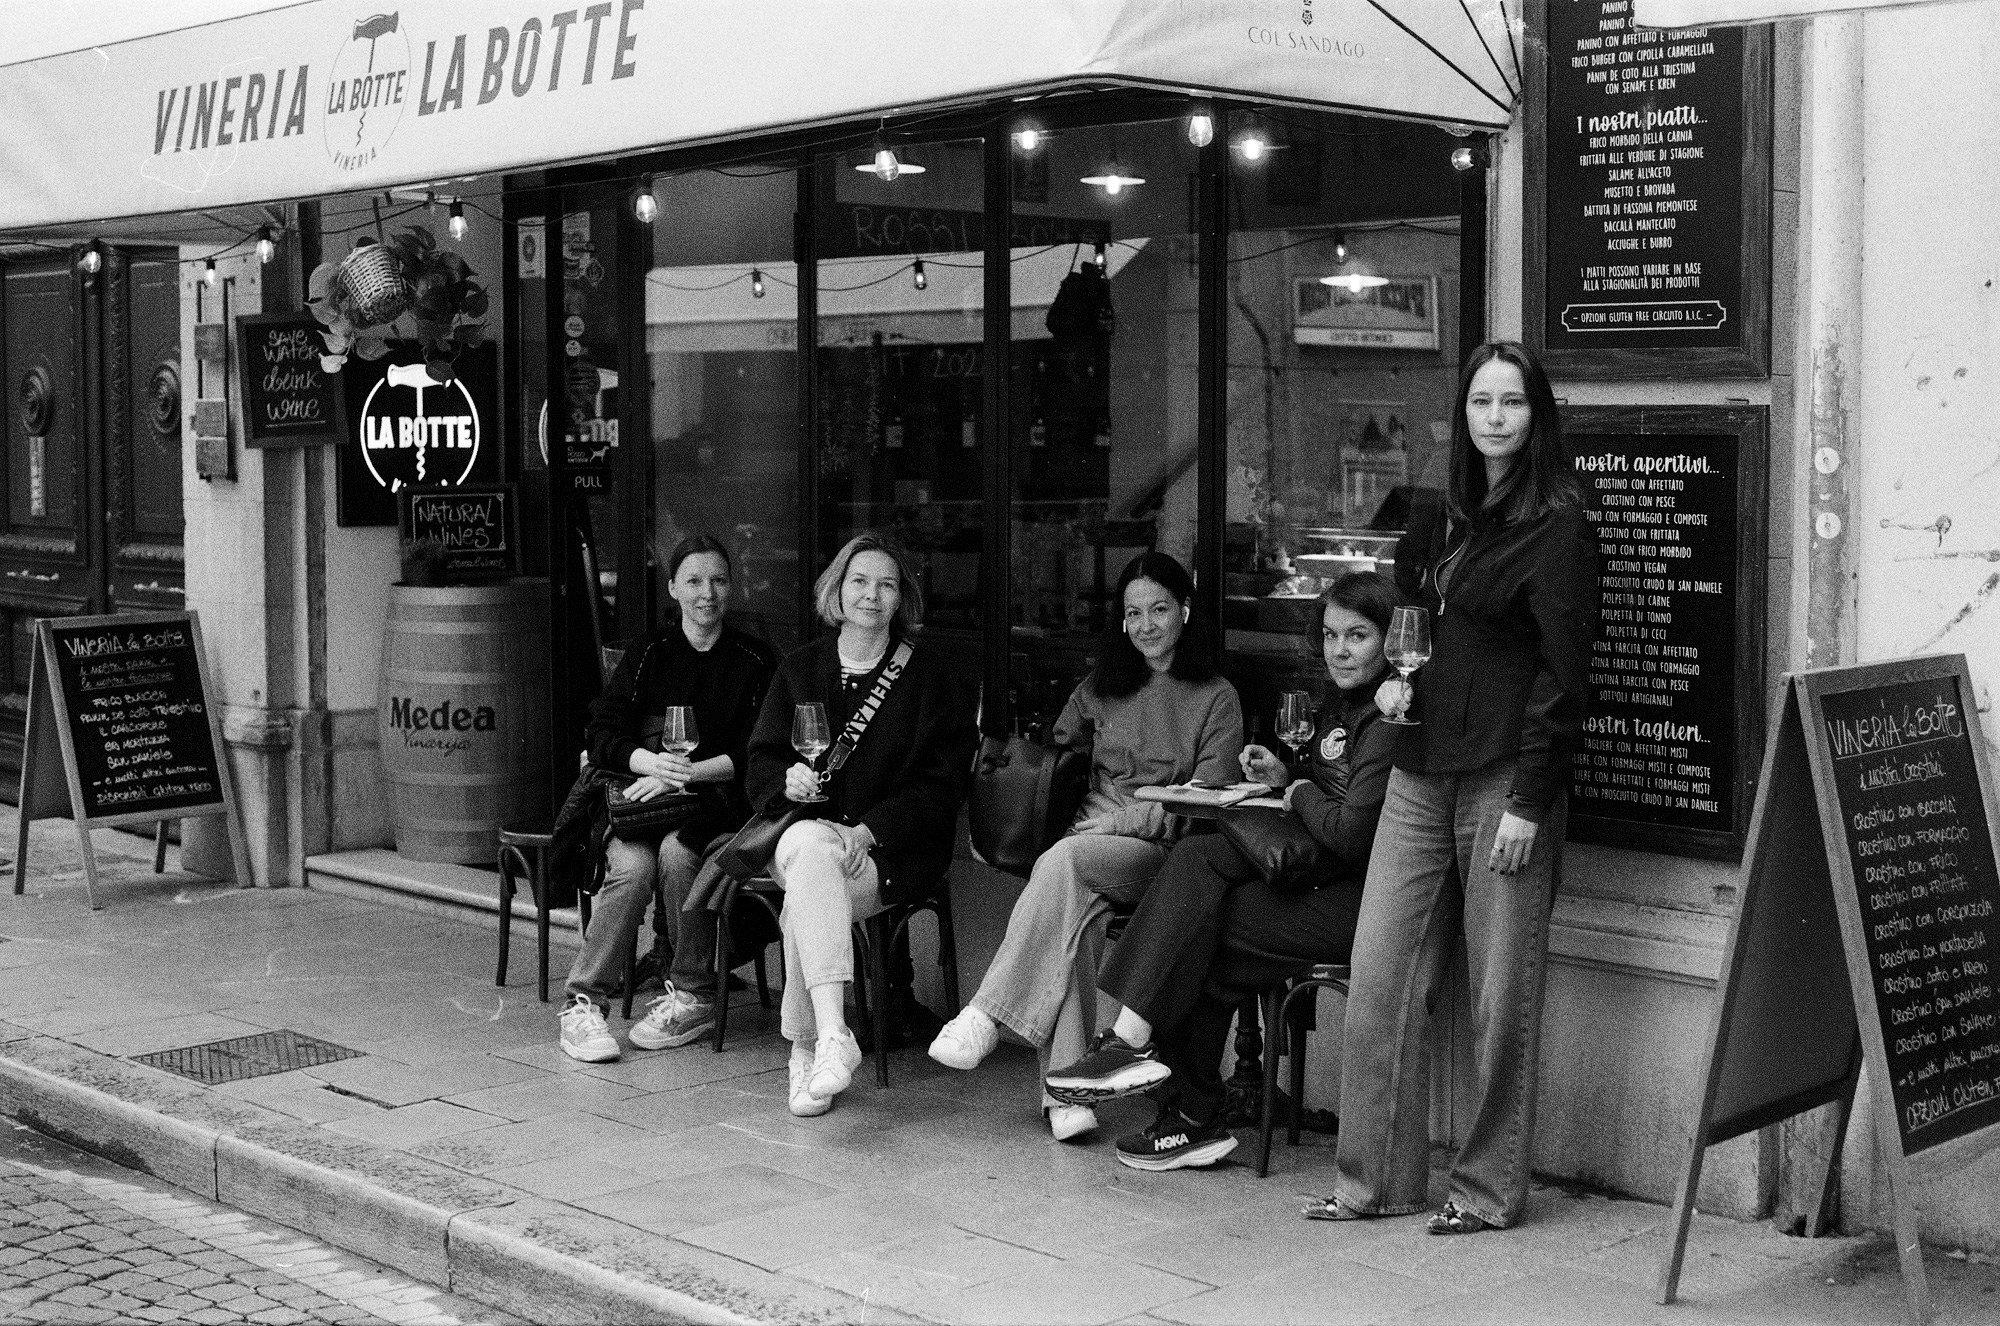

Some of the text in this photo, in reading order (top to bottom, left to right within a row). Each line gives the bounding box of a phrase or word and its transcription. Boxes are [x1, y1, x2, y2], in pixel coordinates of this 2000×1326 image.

[1602, 0, 1627, 14] PANINO
[1600, 19, 1625, 31] PANINO
[1248, 26, 1364, 58] COL SANDAGO
[1577, 37, 1602, 50] PANINO
[1605, 36, 1619, 47] CON
[1622, 29, 1658, 45] AFFETTATO
[418, 0, 646, 117] LA BOTTE
[1572, 43, 1714, 68] FRICO BURGER CON CIPOLLA CARAMELLATA
[1587, 62, 1695, 83] PANIN DE COTO ALLA TRIESTINA
[328, 69, 407, 114] LA BOTTE
[1605, 78, 1675, 94] CON SENAPE KREN
[154, 65, 309, 155] VINERIA
[1589, 111, 1642, 132] nostri
[1590, 130, 1692, 148] FRICO MORBIDO DELLA CARNIA
[334, 147, 377, 172] VINERIA
[1580, 147, 1703, 166] FRITTATA ALLE VERDURE DI STAGIONE
[1609, 169, 1633, 181] SALAME
[1604, 183, 1675, 198] MUSETTO BROVADA
[1584, 200, 1697, 216] BATTUTA DI FASSONA PIEMONTESE
[1604, 218, 1676, 232] BACCALÀ MANTECATO
[1608, 237, 1672, 250] ACCIUGHE BURRO
[1587, 263, 1701, 278] PIATTI POSSONO VARIARE IN BASE
[1584, 276, 1662, 291] ALLA STAGIONALITÀ DEI
[1581, 313, 1606, 322] OPZIONI
[1609, 312, 1632, 322] GLUTEN
[1636, 311, 1649, 321] FREE
[1653, 310, 1683, 321] CIRCUITO
[267, 392, 320, 420] wine
[367, 416, 472, 449] LA BOTTE
[1576, 453, 1629, 471] nostri
[575, 475, 602, 488] PULL
[1595, 478, 1683, 491] CROSTINO CON AFFETTATO
[1602, 495, 1675, 507] CROSTINO CON PESCE
[1605, 511, 1707, 525] CON FORMAGGIO COMPOSTE
[1633, 529, 1679, 540] CON FRITTATA
[1620, 545, 1691, 558] CON FRICO MORBIDO
[1608, 560, 1666, 573] CROSTINO VEGAN
[1603, 577, 1640, 589] PROSCIUTTO
[1643, 579, 1664, 590] CRUDO
[1668, 579, 1674, 591] DI
[1678, 580, 1691, 591] SAN
[1695, 581, 1722, 593] DANIELE
[1603, 592, 1670, 607] POLPETTA DI CARNE
[1602, 609, 1671, 623] POLPETTA DI TONNO
[1606, 626, 1666, 640] POLPETTA DI CECI
[1615, 642, 1697, 658] FARCITA CON AFFETTATO
[1613, 658, 1699, 675] FARCITA CON FORMAGGIO
[1623, 676, 1688, 691] FARCITA CON PESCE
[1632, 693, 1672, 706] ARTIGIANALI
[391, 697, 496, 731] Medea
[1585, 738, 1688, 759] TAGLIERE CON AFFETTATI MISTI
[1594, 755, 1710, 778] CON FORMAGGI MISTI COMPOSTE
[1595, 772, 1710, 794] CON AFFETTATI FORMAGGI MISTI
[1585, 787, 1598, 797] CON
[1602, 788, 1638, 802] PROSCIUTTO
[1641, 793, 1662, 805] CRUDO
[1665, 795, 1672, 806] DI
[1676, 797, 1688, 808] SAN
[1691, 799, 1718, 812] DANIELE
[1154, 1133, 1190, 1150] HOKA
